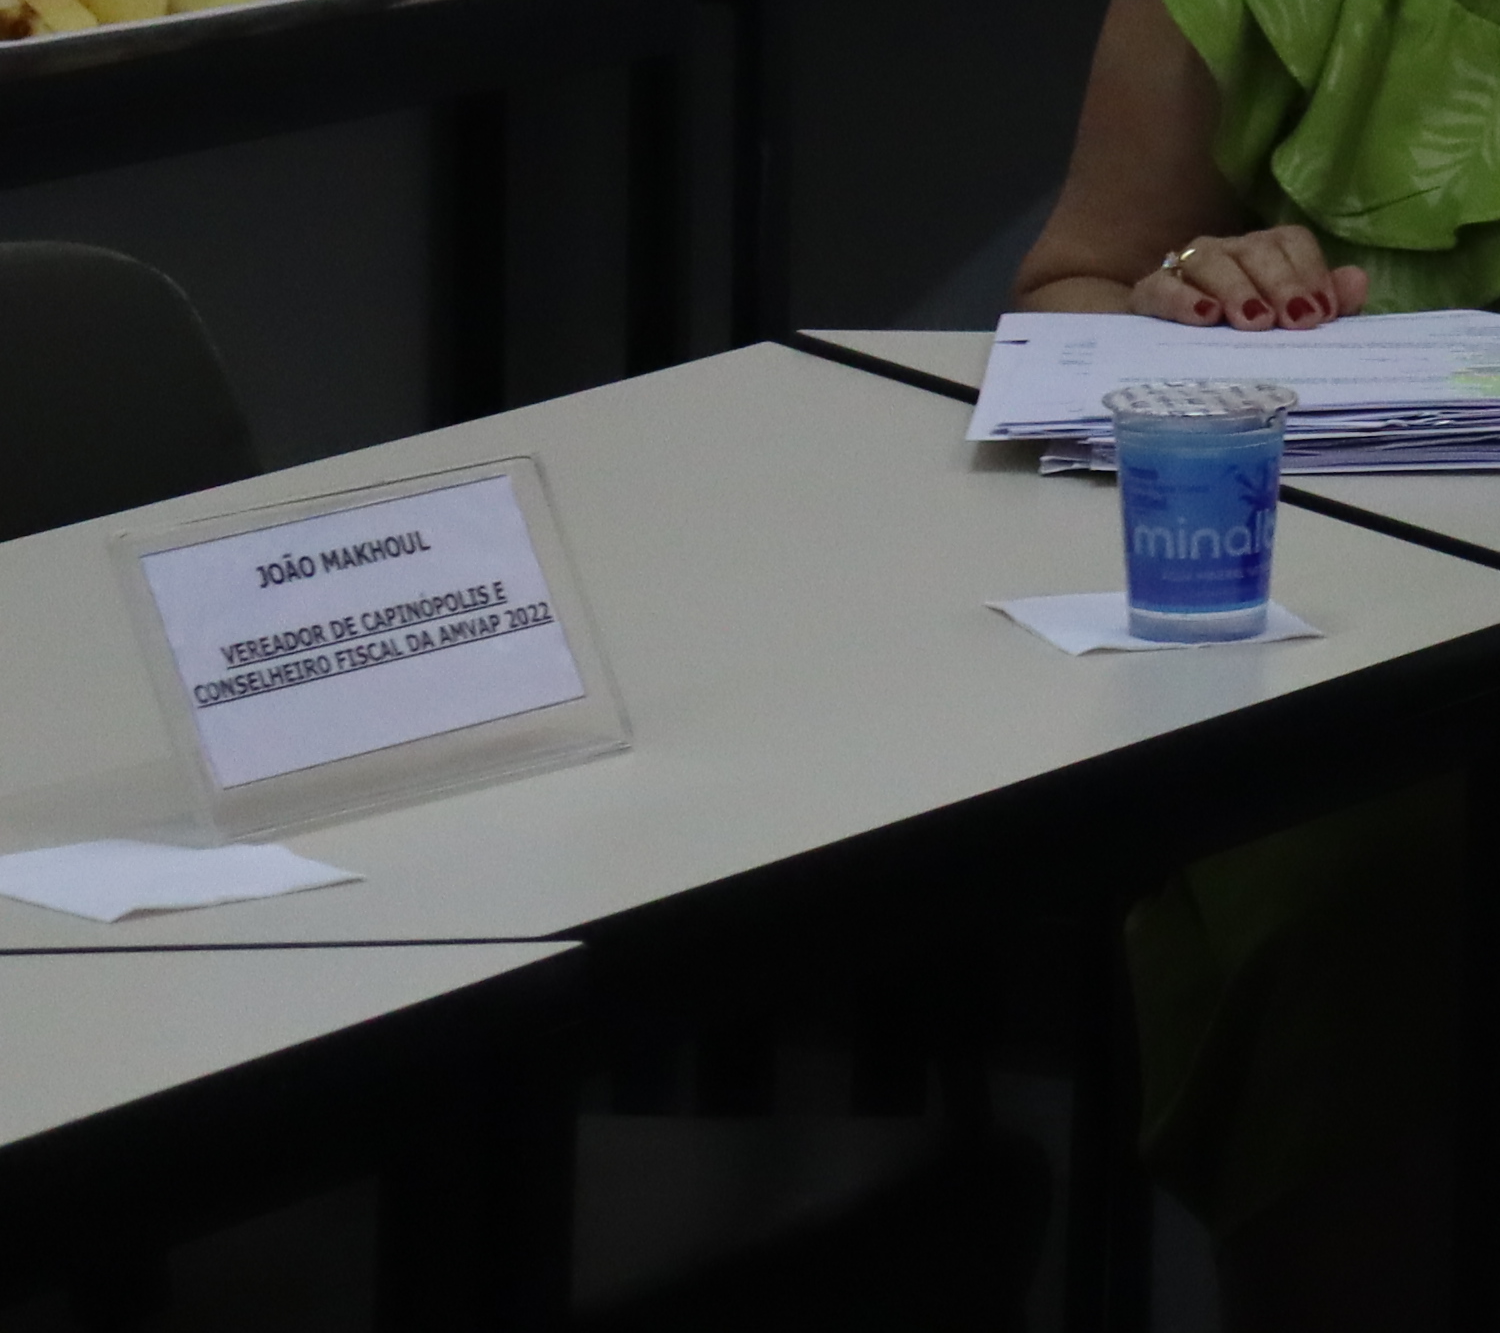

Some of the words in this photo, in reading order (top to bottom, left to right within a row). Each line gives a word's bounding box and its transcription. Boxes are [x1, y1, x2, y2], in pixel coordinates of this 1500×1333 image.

[256, 553, 316, 589] JOÃO
[319, 531, 431, 574] MAKHOUL
[193, 654, 332, 704] CONSELHEIRO
[336, 636, 403, 670] FISCAL
[405, 630, 435, 653] DA
[439, 614, 501, 645] AMVAP
[504, 601, 553, 630] 2022
[220, 624, 326, 666] VEREADOR
[329, 618, 358, 640] DE
[361, 584, 490, 630] CAPINÓPOLIS
[492, 580, 507, 602] E
